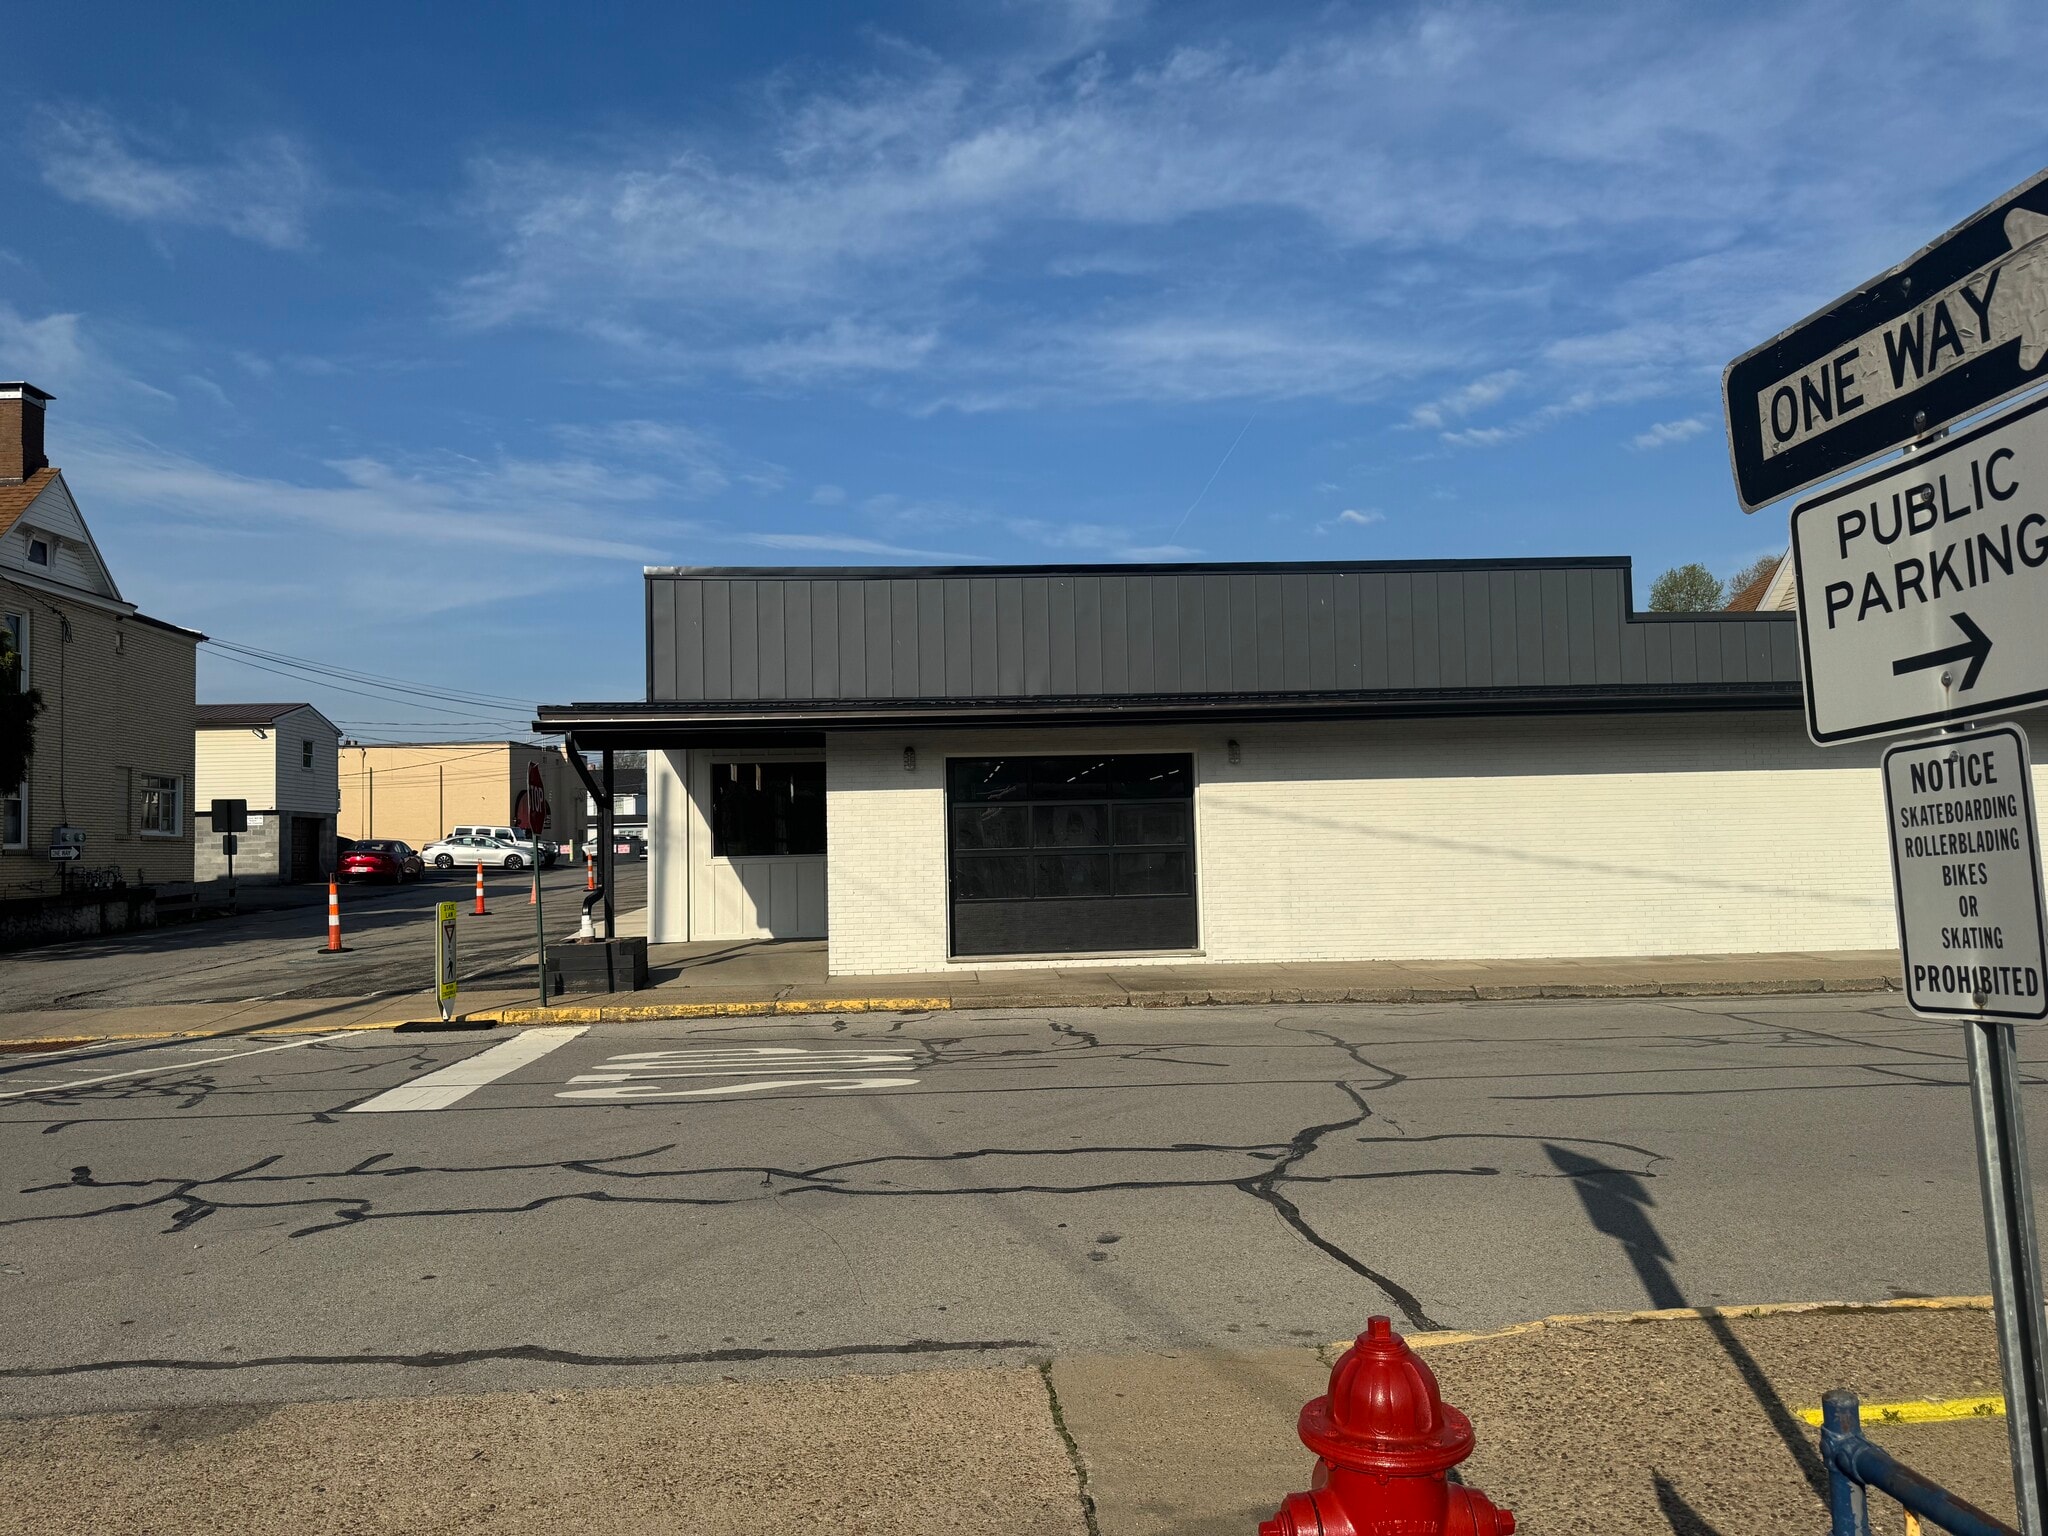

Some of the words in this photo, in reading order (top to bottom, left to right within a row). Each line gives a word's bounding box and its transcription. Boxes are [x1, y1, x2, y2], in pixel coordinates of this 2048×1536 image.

[1771, 347, 1865, 443] ONE
[1883, 266, 2002, 390] WAY
[1837, 448, 2019, 559] PUBLIC
[1825, 513, 2048, 630] PARKING
[1910, 751, 1998, 794] NOTICE
[529, 785, 544, 813] TOP
[1900, 794, 2018, 828] SKATEBOARDING
[1904, 827, 2020, 858] ROLLERBLADING
[1942, 862, 1988, 887] BIKES
[443, 903, 455, 911] STATE
[1958, 895, 1979, 918] OR
[1941, 926, 2004, 950] SKATING
[1913, 964, 2039, 997] PROHIBITED
[554, 1048, 921, 1098] STOP
